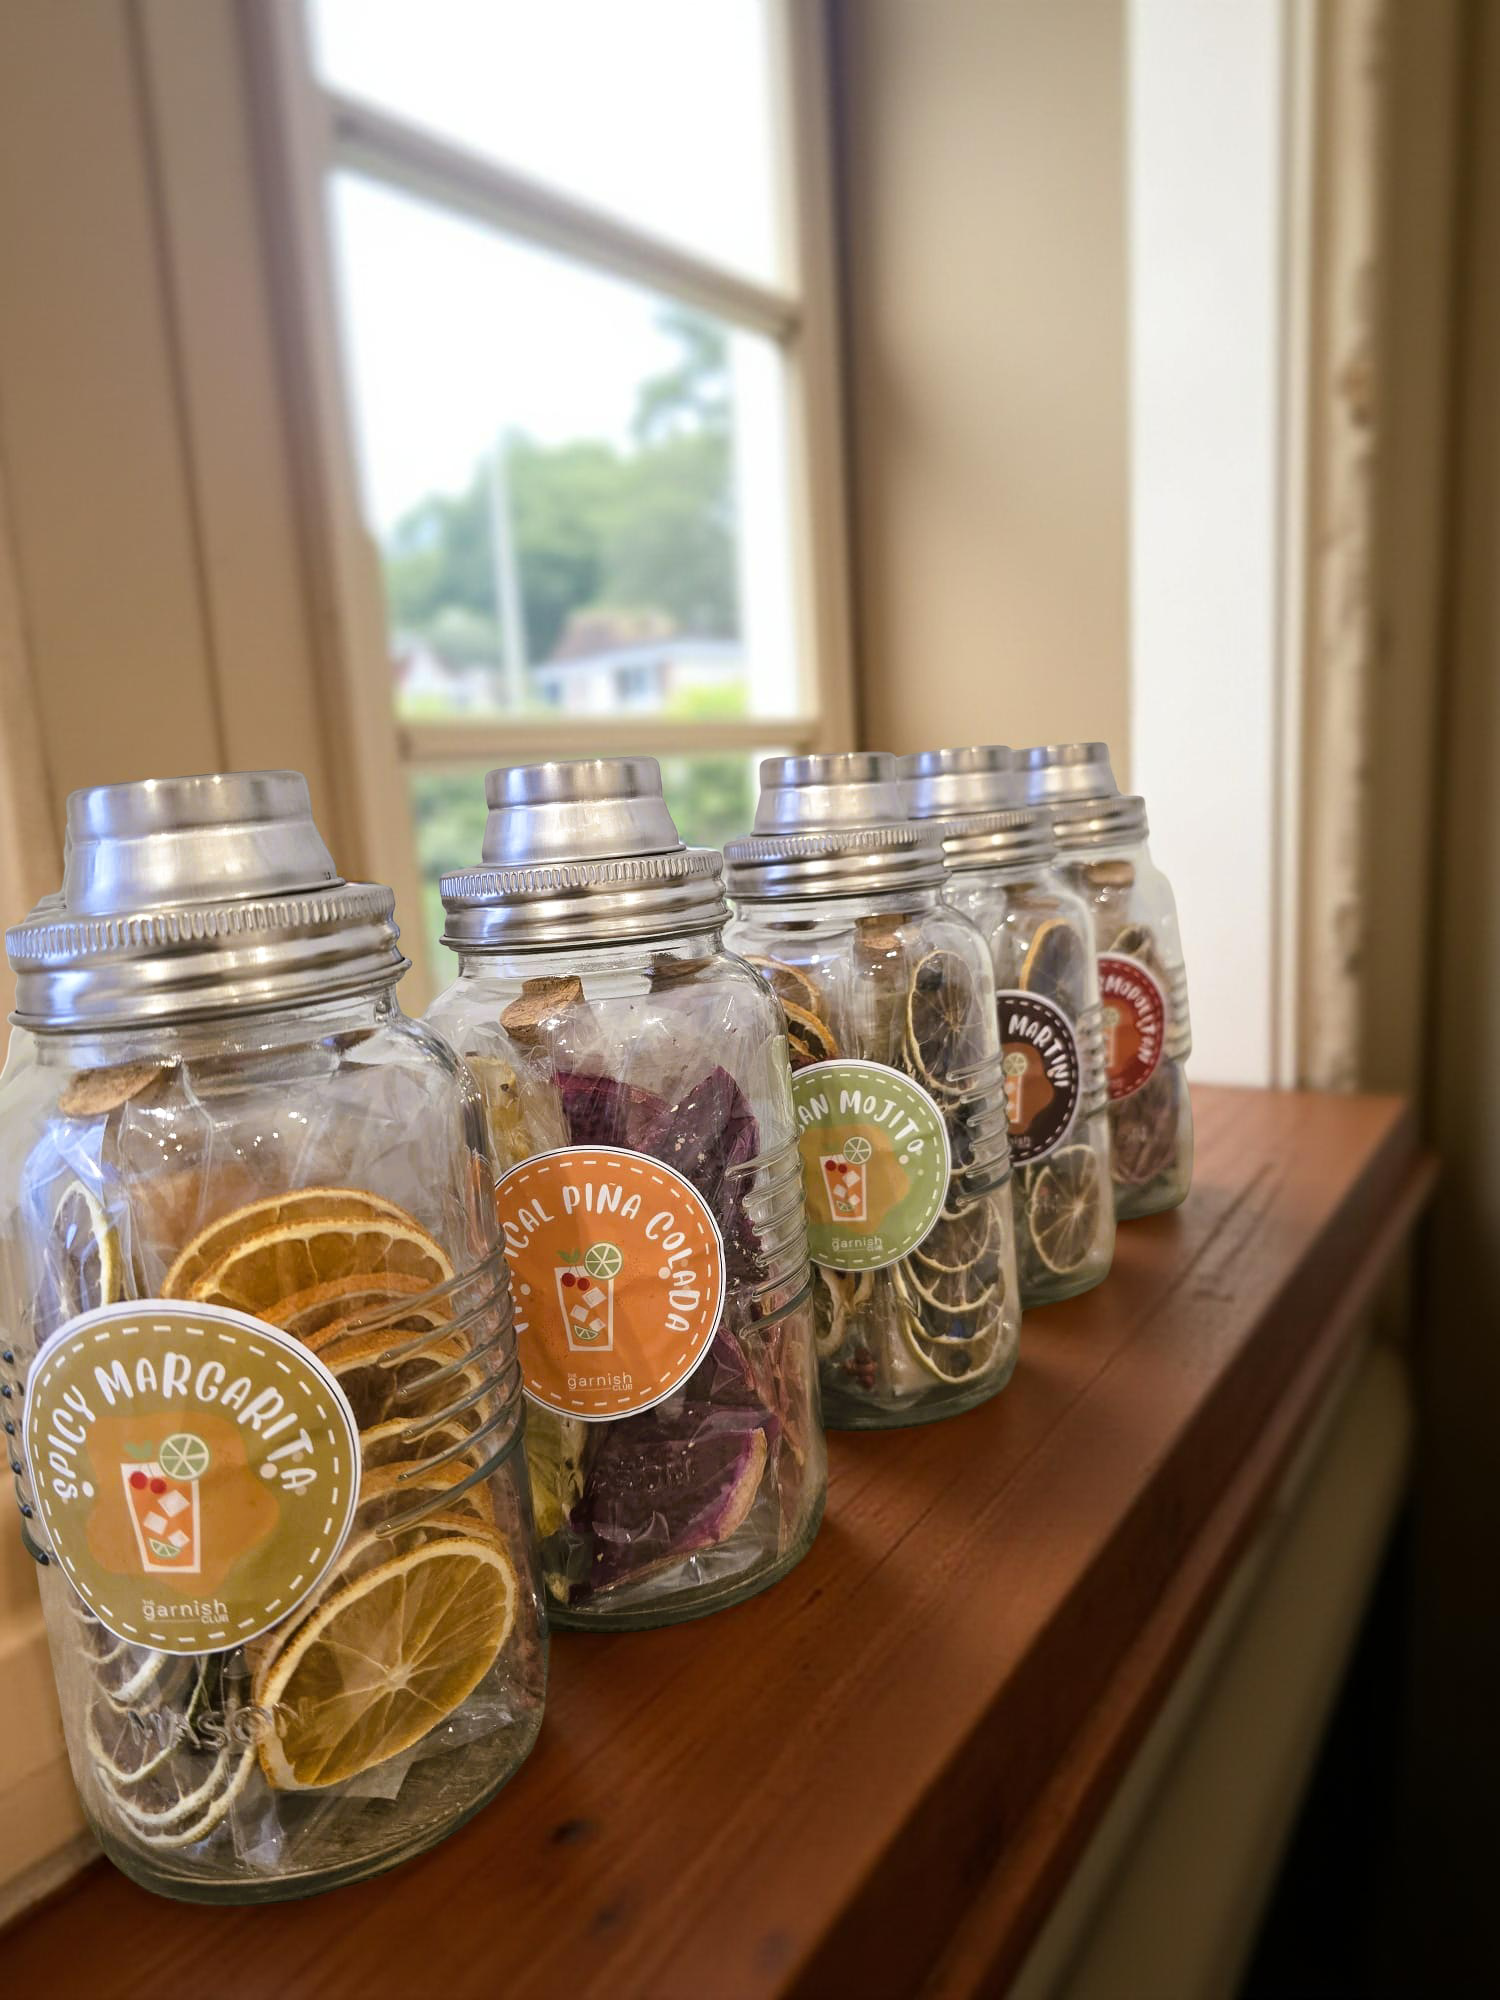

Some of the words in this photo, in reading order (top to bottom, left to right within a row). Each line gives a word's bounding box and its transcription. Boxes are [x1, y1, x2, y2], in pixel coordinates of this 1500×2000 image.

[1008, 1014, 1069, 1087] MARTINI
[1100, 973, 1156, 1065] MOPOLITAN
[840, 1089, 925, 1153] MOJITO
[562, 1182, 642, 1221] PIÑA
[645, 1211, 701, 1332] COLADA
[831, 1235, 883, 1252] garnish
[567, 1371, 633, 1390] garnish
[47, 1384, 96, 1500] SPICY
[94, 1351, 318, 1492] MARGARITA
[142, 1599, 229, 1622] garnish
